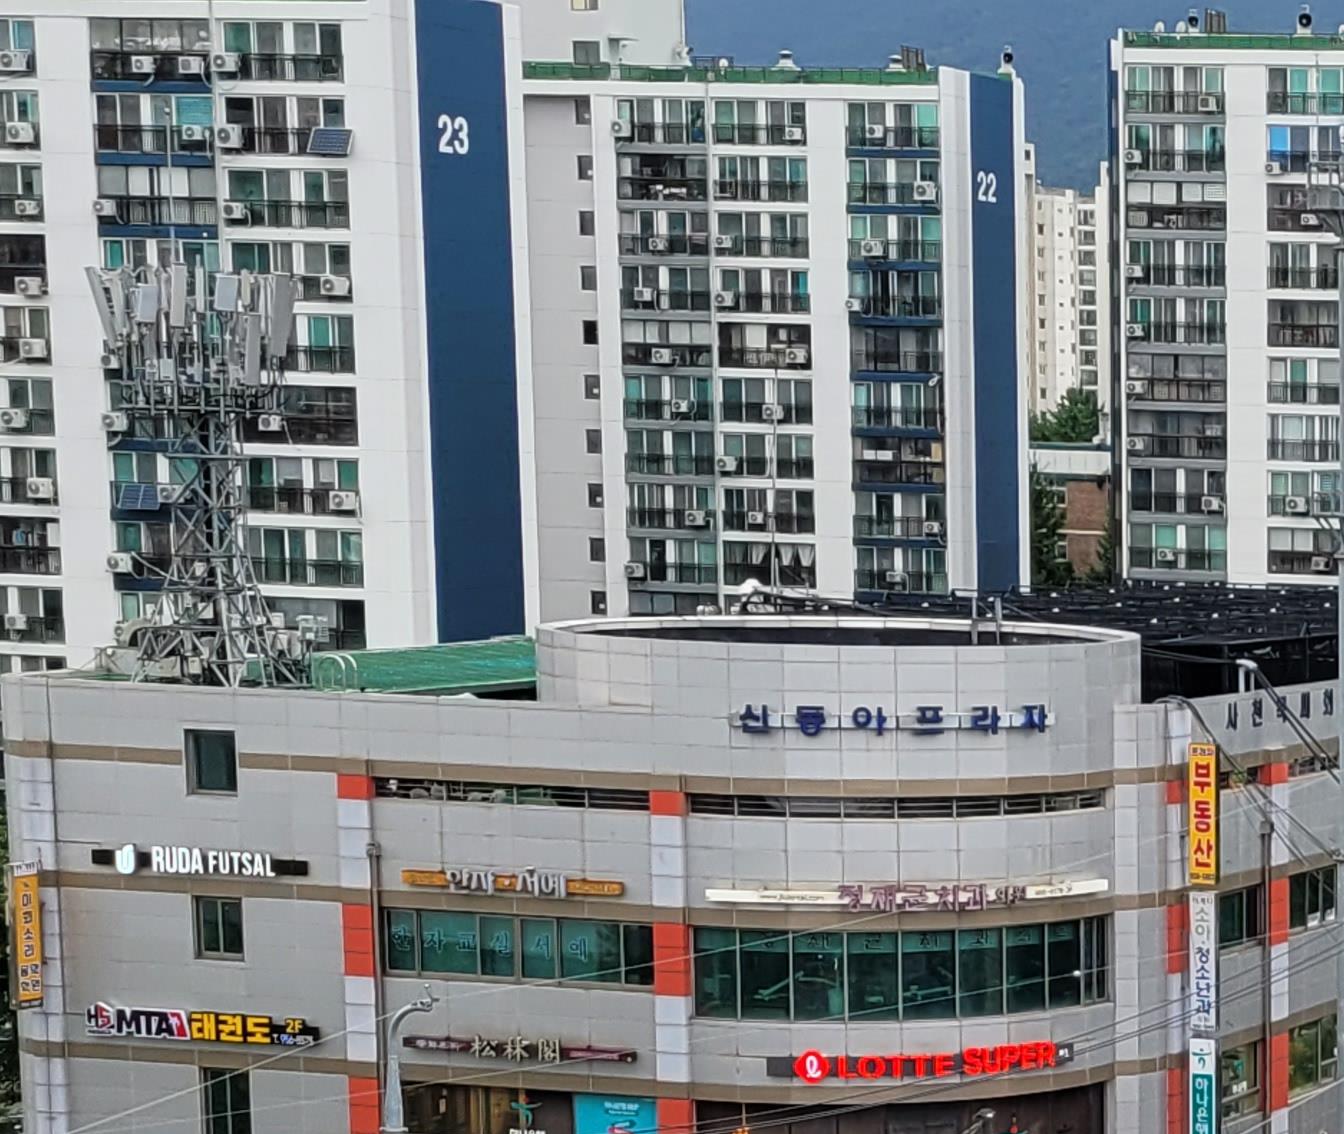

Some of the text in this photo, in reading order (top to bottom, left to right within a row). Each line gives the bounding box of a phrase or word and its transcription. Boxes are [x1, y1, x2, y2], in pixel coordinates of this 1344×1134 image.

[437, 113, 469, 155] 23
[977, 170, 997, 203] 22
[739, 703, 1048, 737] 신동아프라자
[1193, 760, 1214, 869] 부동산
[151, 846, 276, 878] RUDA FUTSAL
[116, 1009, 175, 1038] MTA
[190, 1012, 272, 1045] 태권도
[285, 1018, 303, 1034] 2F
[837, 1040, 1057, 1081] LOTTE SUPER
